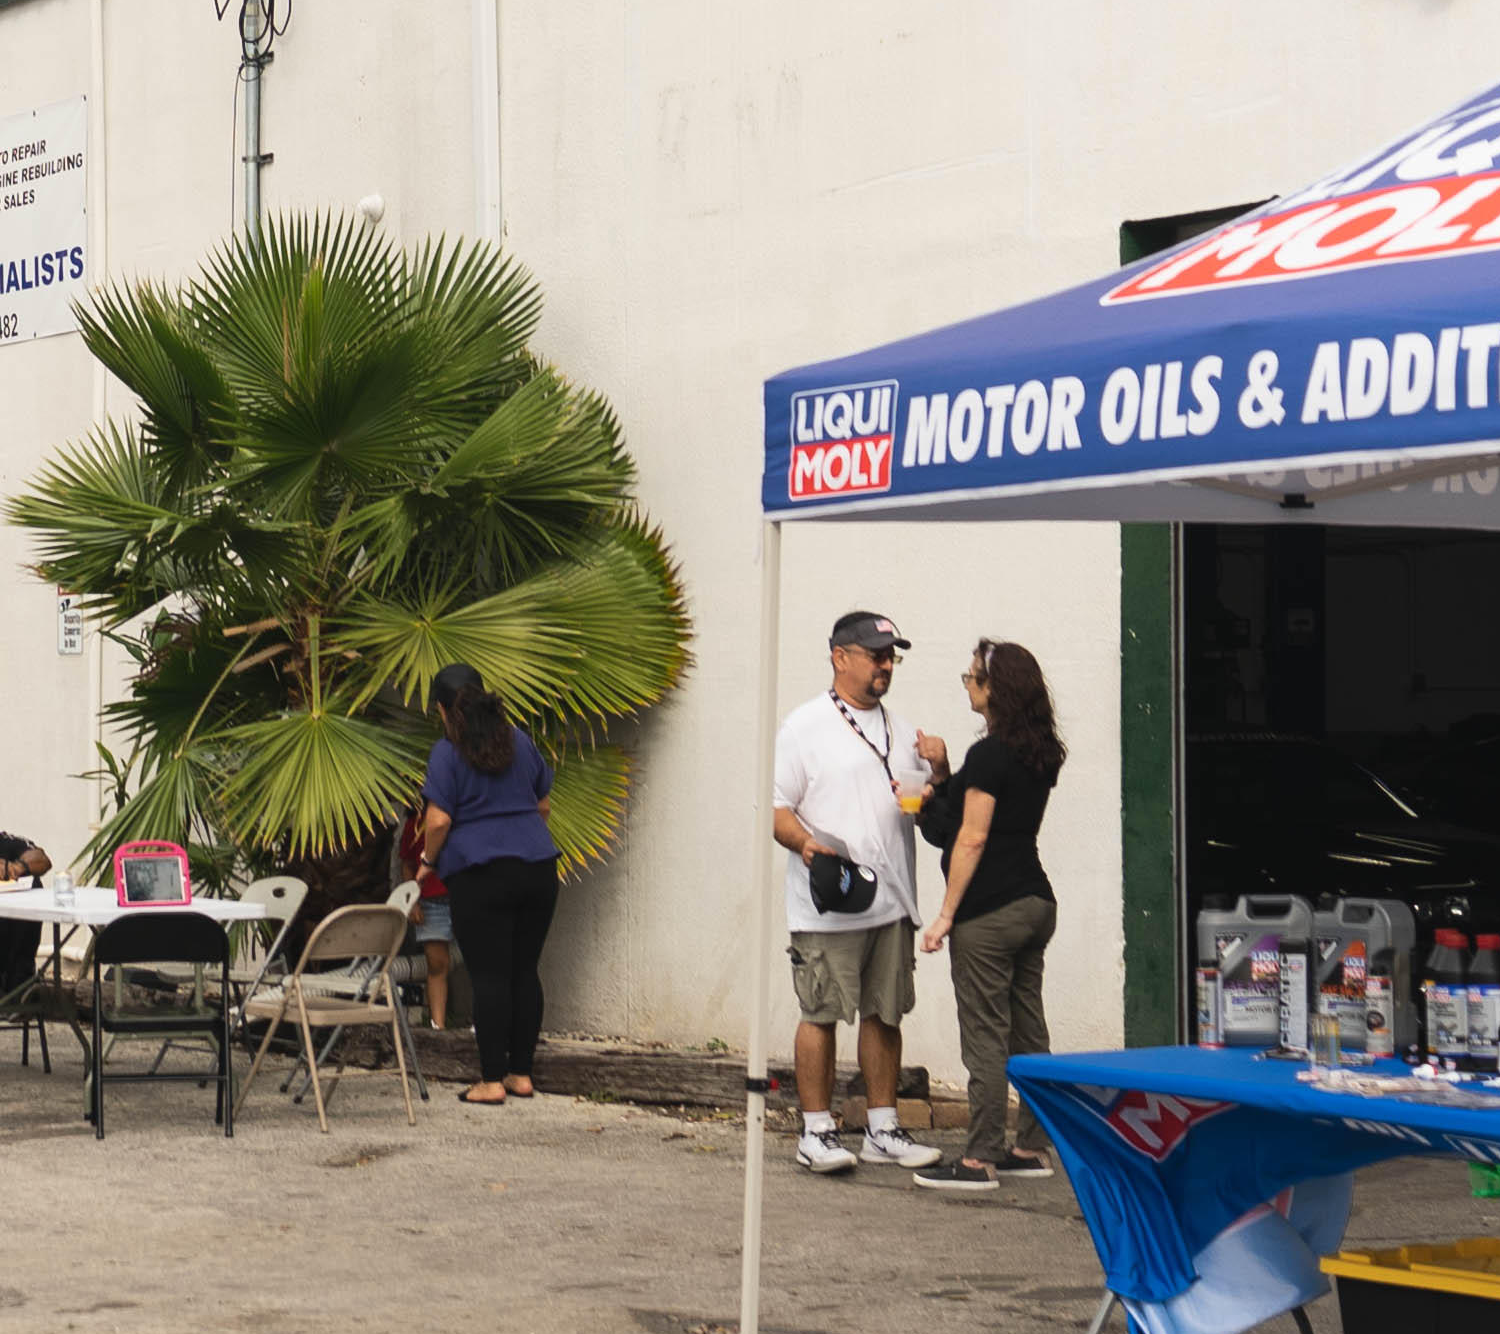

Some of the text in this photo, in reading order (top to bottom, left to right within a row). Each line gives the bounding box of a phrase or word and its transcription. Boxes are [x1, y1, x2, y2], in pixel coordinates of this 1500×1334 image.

[12, 140, 46, 163] REPAIR
[21, 153, 83, 183] REBUILDING
[4, 189, 35, 211] SALES
[796, 386, 892, 443] LIQUI
[902, 376, 1086, 468] MOTOR
[1100, 354, 1222, 446] OILS
[1237, 349, 1286, 429] &
[794, 438, 890, 493] MOLY
